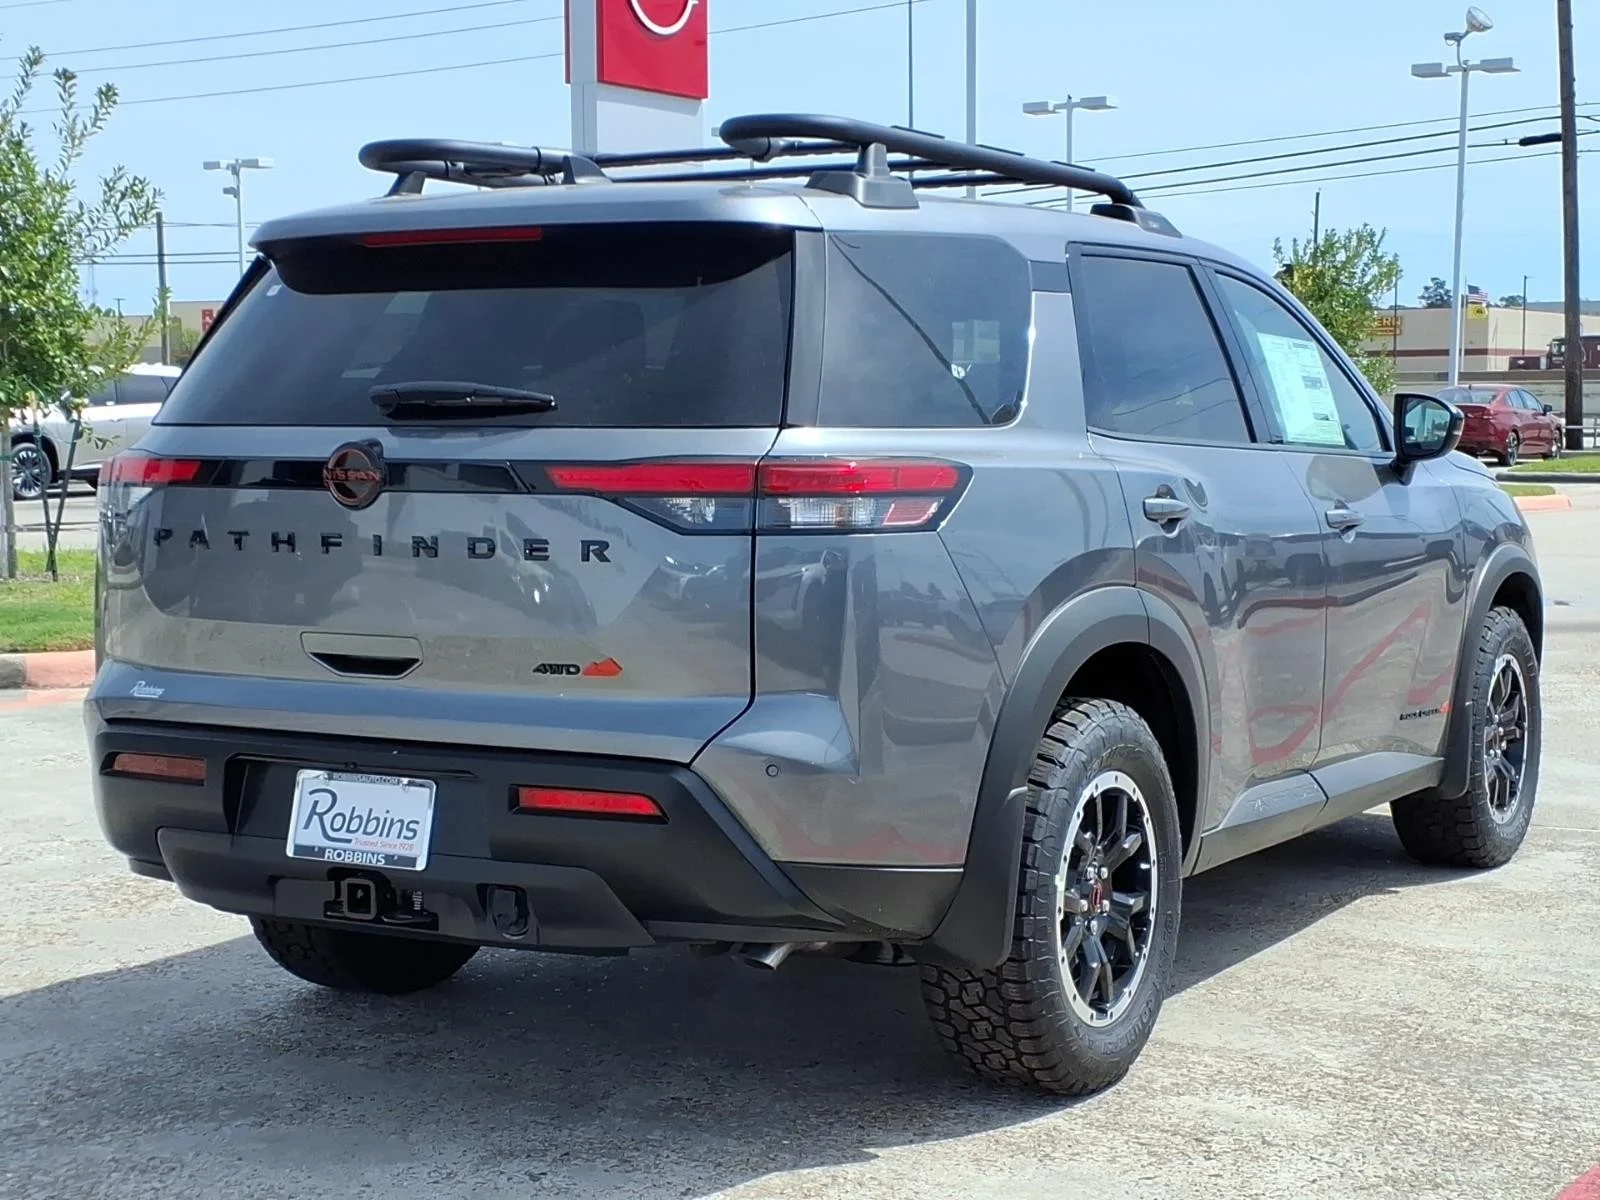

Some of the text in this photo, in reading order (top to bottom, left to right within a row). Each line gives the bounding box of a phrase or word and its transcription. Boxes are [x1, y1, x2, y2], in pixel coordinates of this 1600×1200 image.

[323, 470, 380, 481] NISSAN
[153, 528, 612, 563] PATHFINDER
[532, 663, 581, 676] 4WD
[302, 788, 420, 844] Robbins
[324, 849, 386, 865] ROBBINS
